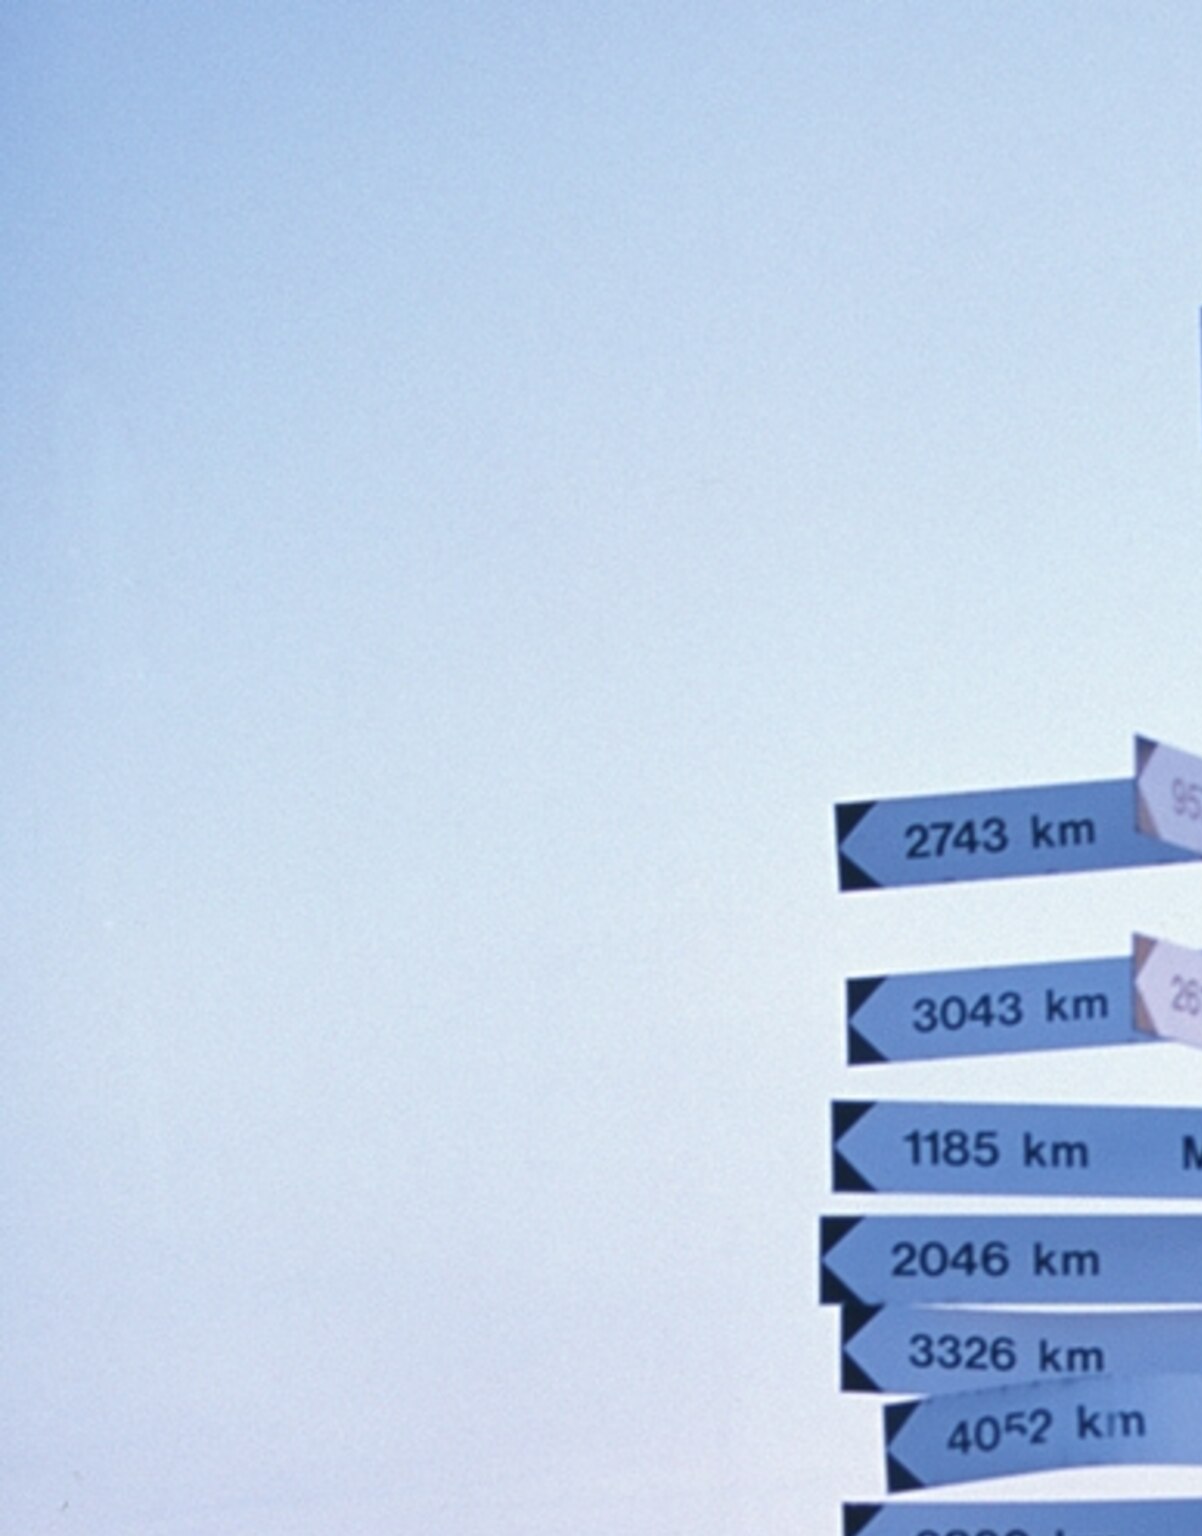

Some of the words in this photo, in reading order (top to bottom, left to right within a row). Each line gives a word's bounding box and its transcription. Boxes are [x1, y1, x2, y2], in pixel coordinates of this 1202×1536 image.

[904, 816, 1009, 860] 2743
[1030, 814, 1096, 849] km
[912, 990, 1024, 1034] 3043
[1045, 988, 1109, 1023] km
[903, 1129, 1000, 1168] 1185
[1023, 1131, 1089, 1168] km
[891, 1240, 1010, 1278] 2046
[1033, 1241, 1100, 1276] km
[908, 1332, 1017, 1372] 3326
[1038, 1338, 1105, 1373] km
[946, 1407, 1053, 1455] 4052
[1075, 1404, 1146, 1440] km
